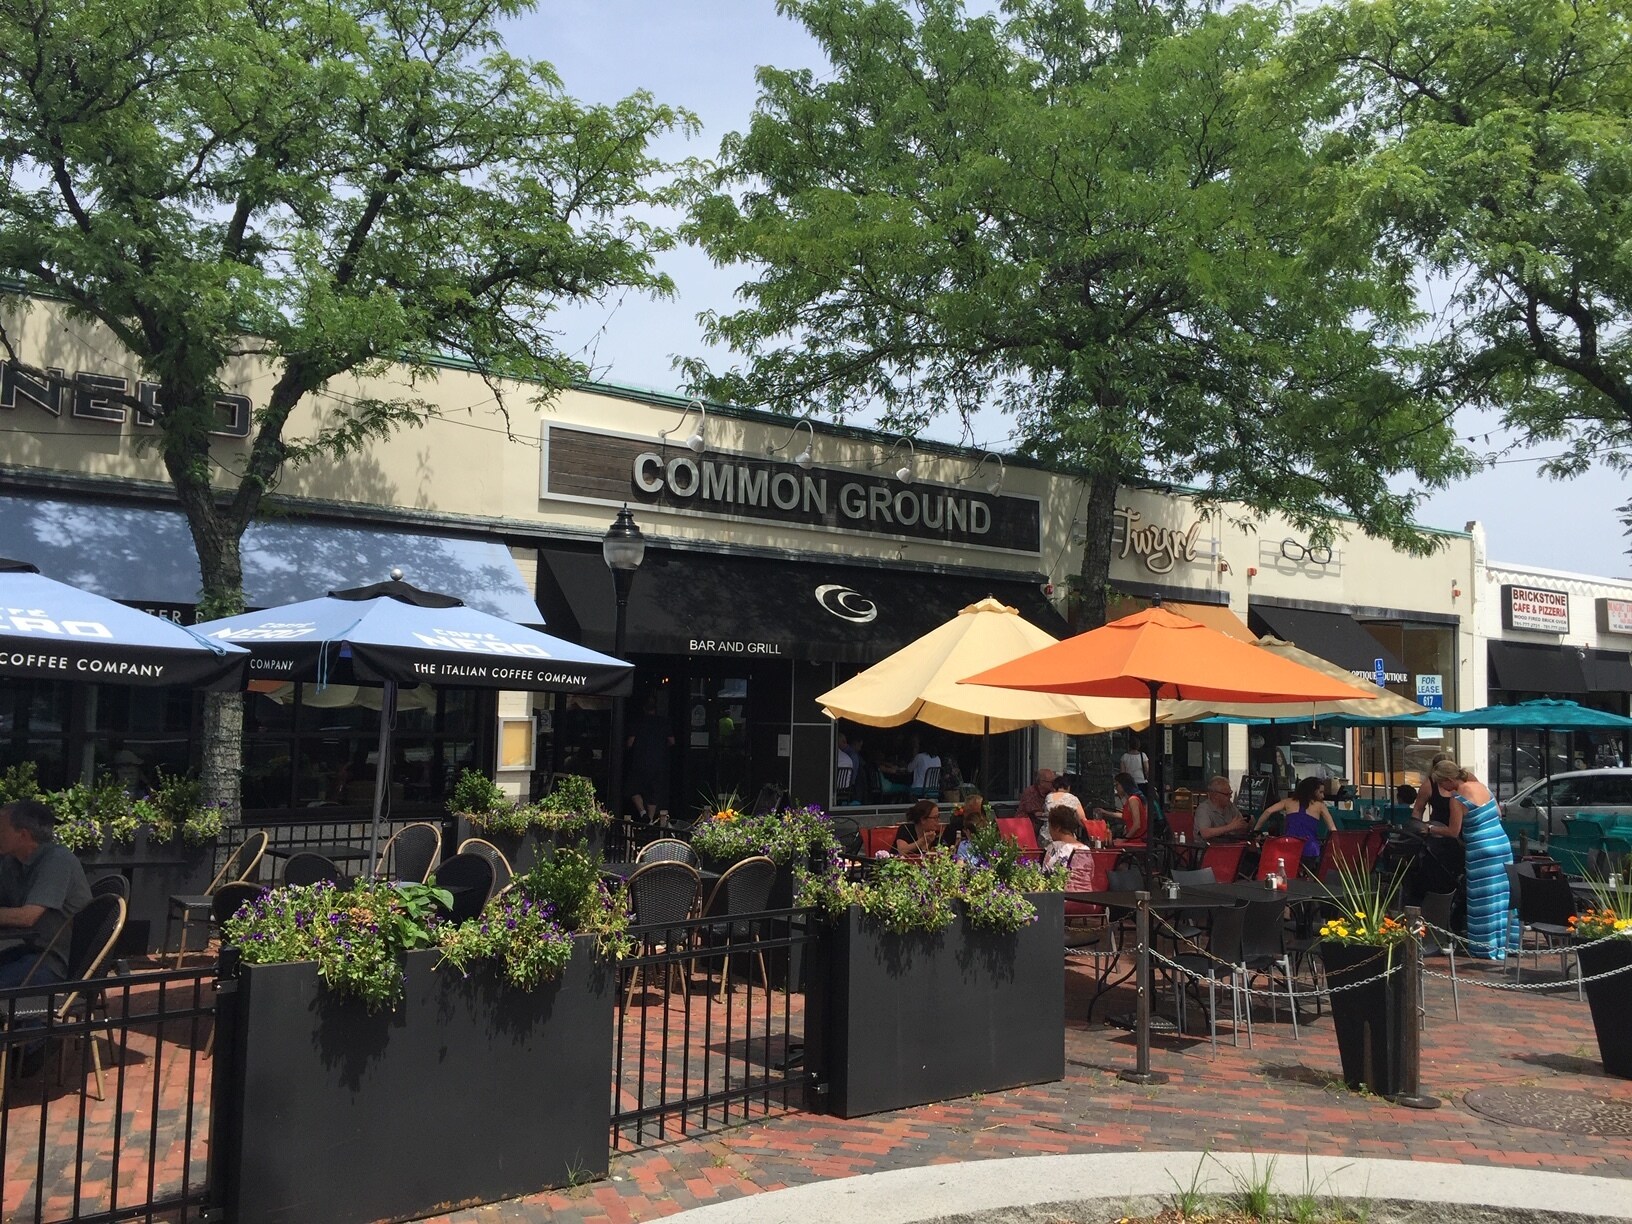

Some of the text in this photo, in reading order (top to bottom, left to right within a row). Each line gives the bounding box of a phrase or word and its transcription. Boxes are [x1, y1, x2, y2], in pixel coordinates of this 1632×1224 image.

[633, 452, 992, 535] COMMON GROUND
[1113, 507, 1201, 574] Twyrl
[1513, 589, 1566, 606] BRICKSTONE
[1513, 602, 1567, 618] CAFE & PIZZERIA
[411, 632, 552, 658] NERO
[689, 640, 782, 654] BAR AND GRILL
[76, 658, 164, 678] COMPANY
[250, 658, 294, 671] COMPANY
[413, 663, 588, 686] THE ITALIAN COFFEE COMPANY
[1421, 676, 1436, 685] FOR
[1417, 685, 1440, 694] LEASE
[1422, 696, 1434, 706] 617
